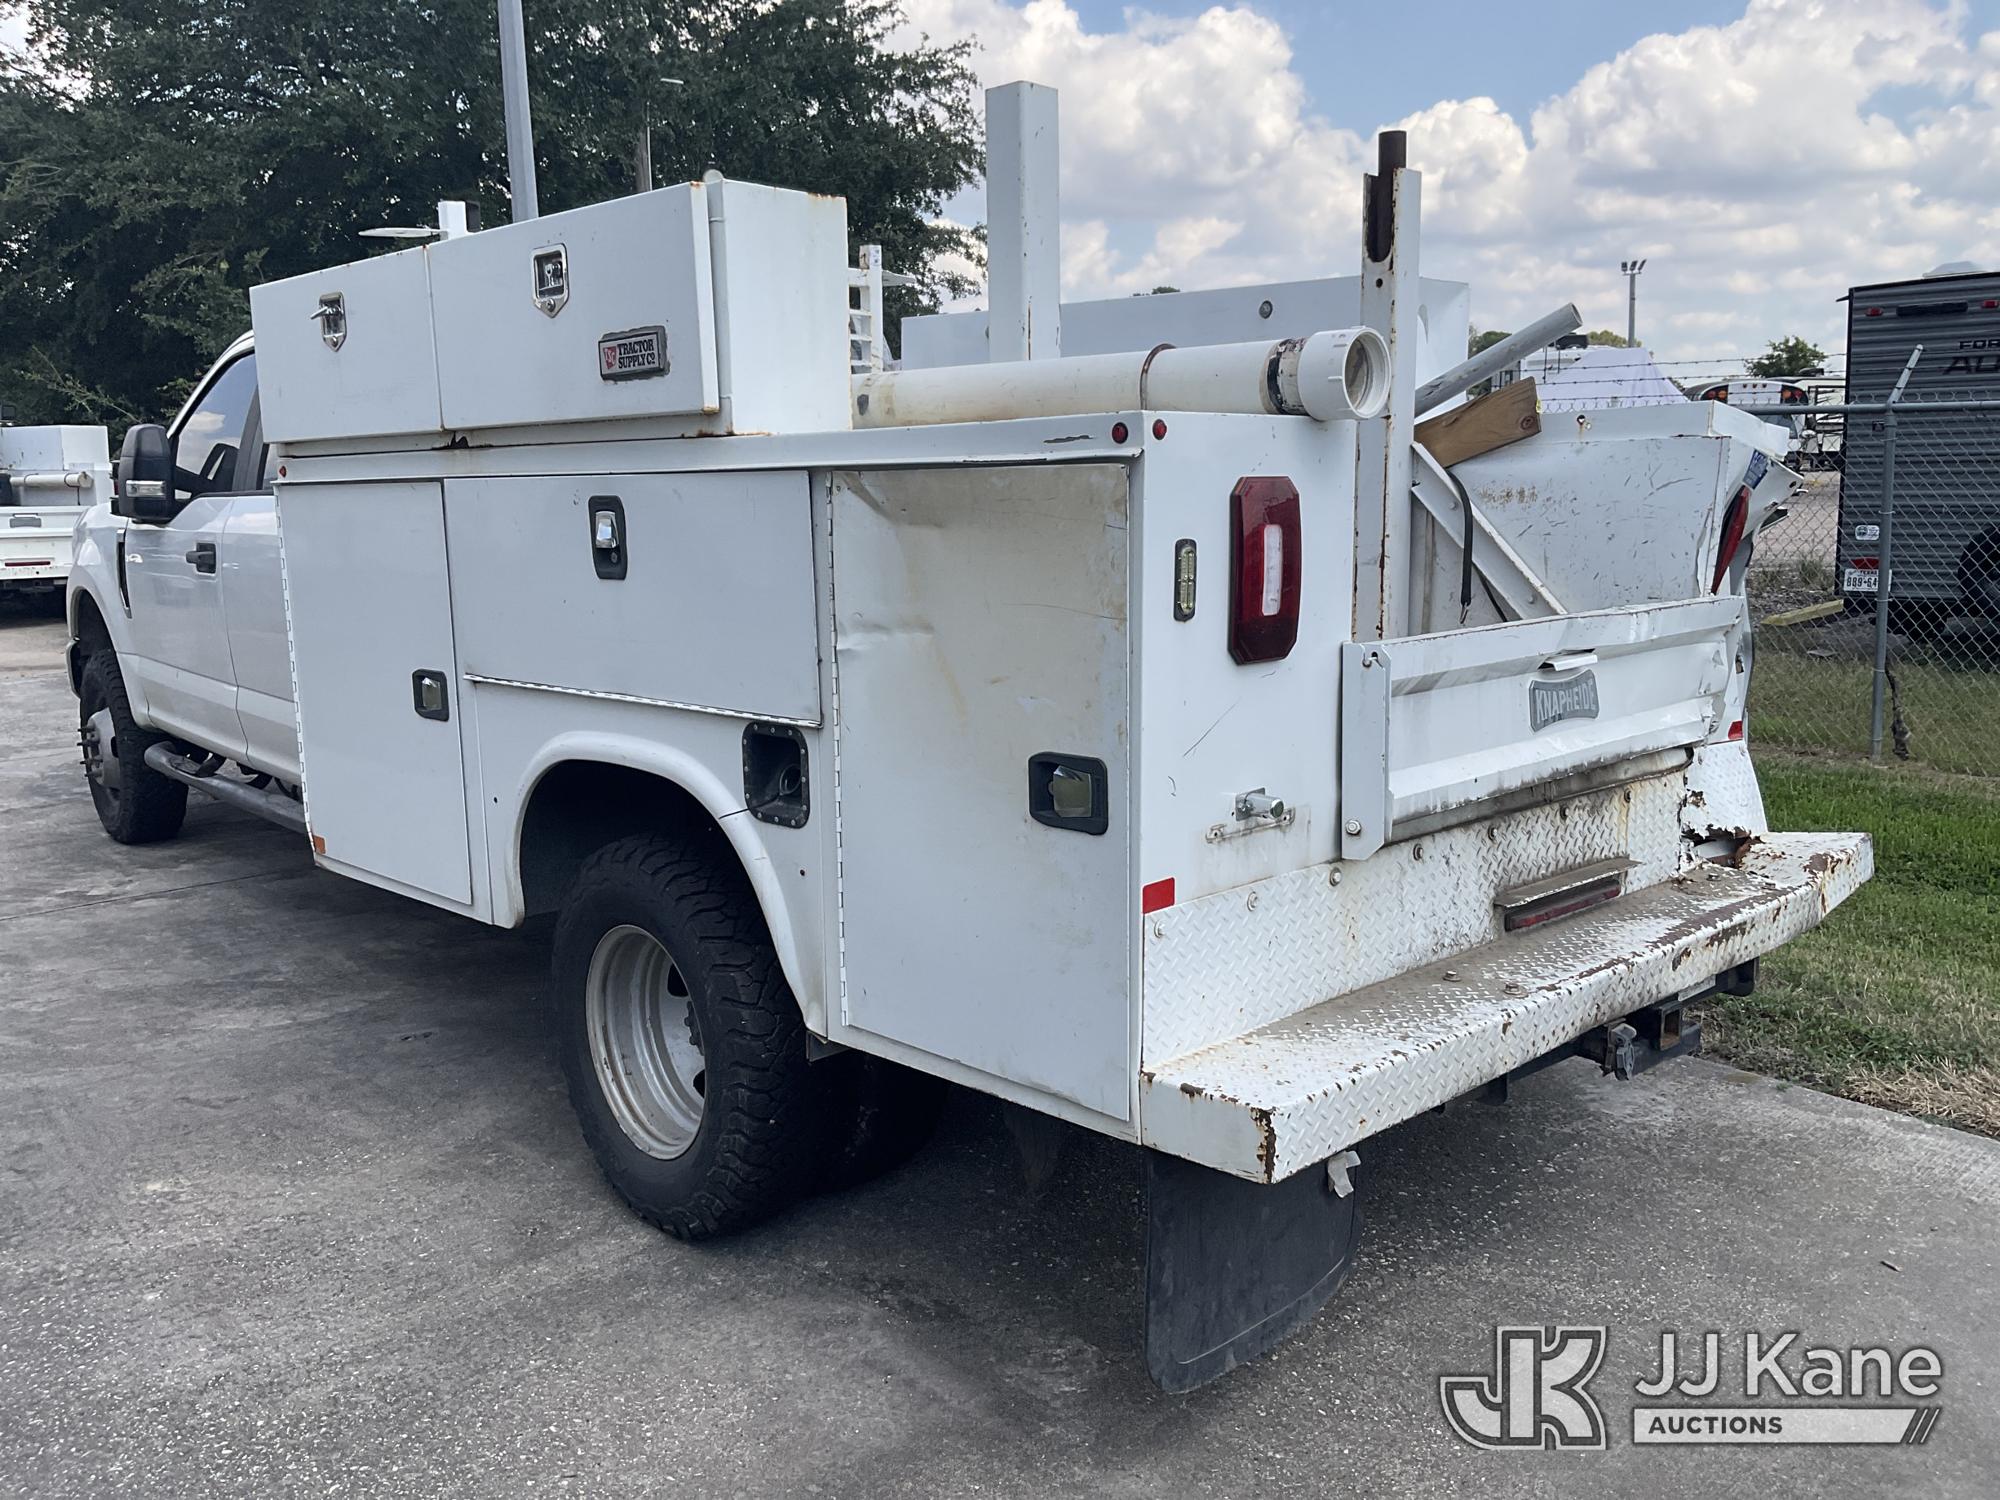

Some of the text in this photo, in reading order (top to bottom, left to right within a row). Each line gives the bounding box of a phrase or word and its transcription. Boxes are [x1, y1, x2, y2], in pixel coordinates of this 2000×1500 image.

[617, 339, 654, 356] TRACTOR
[618, 354, 646, 369] SUPPLY
[1535, 678, 1597, 724] KNAPHEIDE
